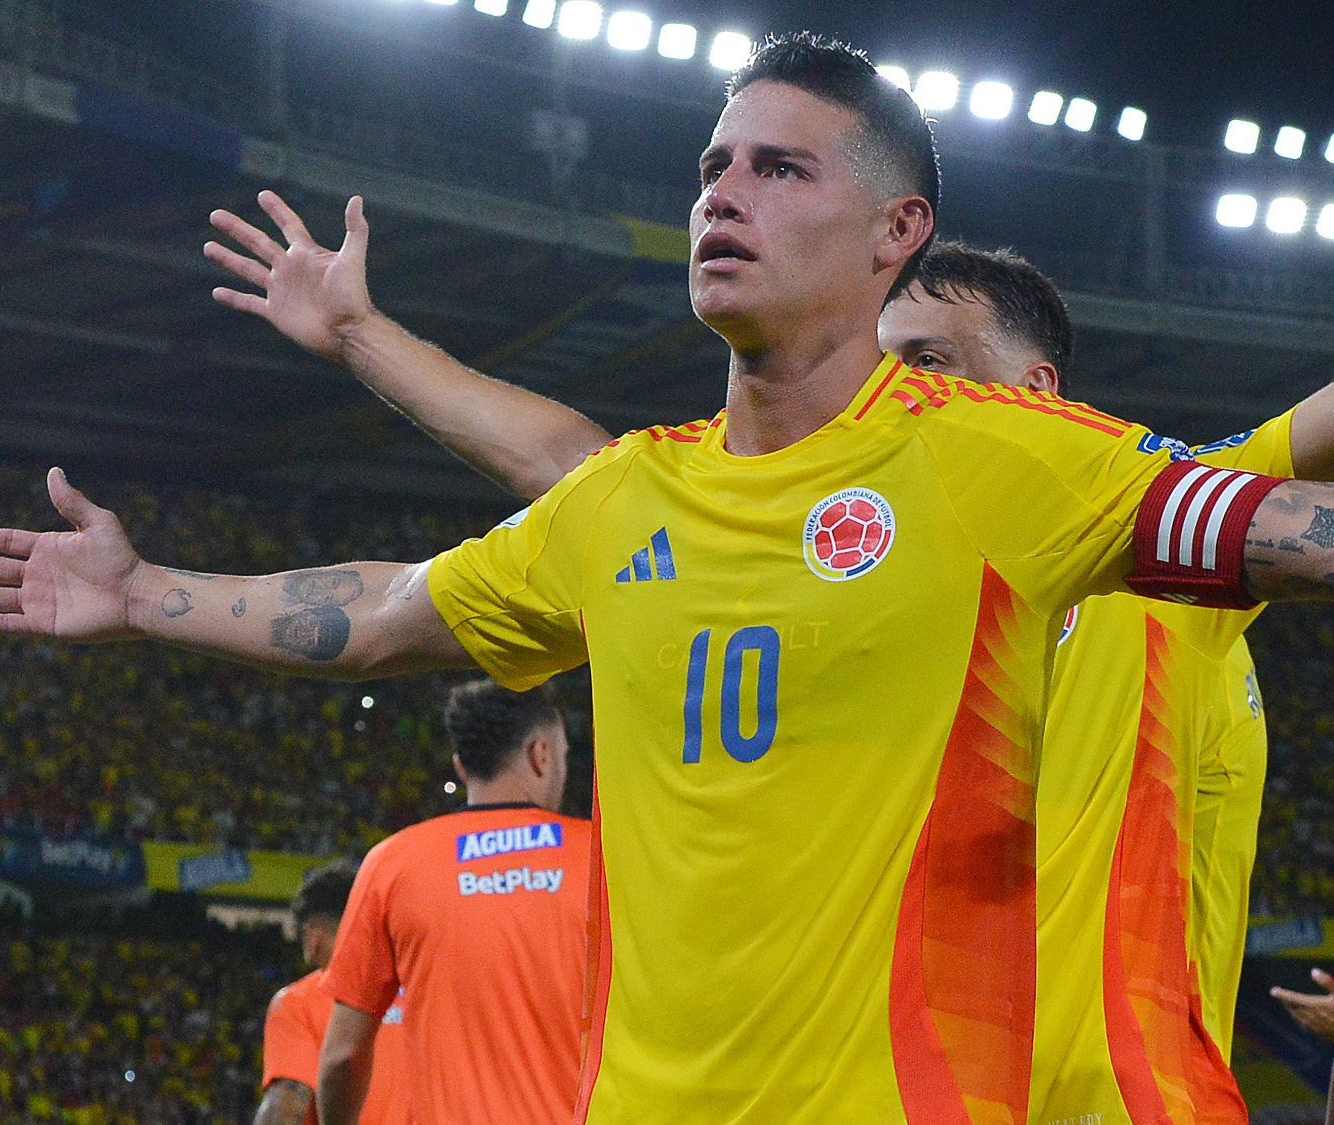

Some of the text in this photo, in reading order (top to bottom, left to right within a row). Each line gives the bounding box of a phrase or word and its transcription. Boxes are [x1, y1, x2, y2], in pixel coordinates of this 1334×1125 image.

[682, 625, 780, 764] 10
[461, 823, 558, 860] AGUILA
[458, 865, 564, 896] BetPlay
